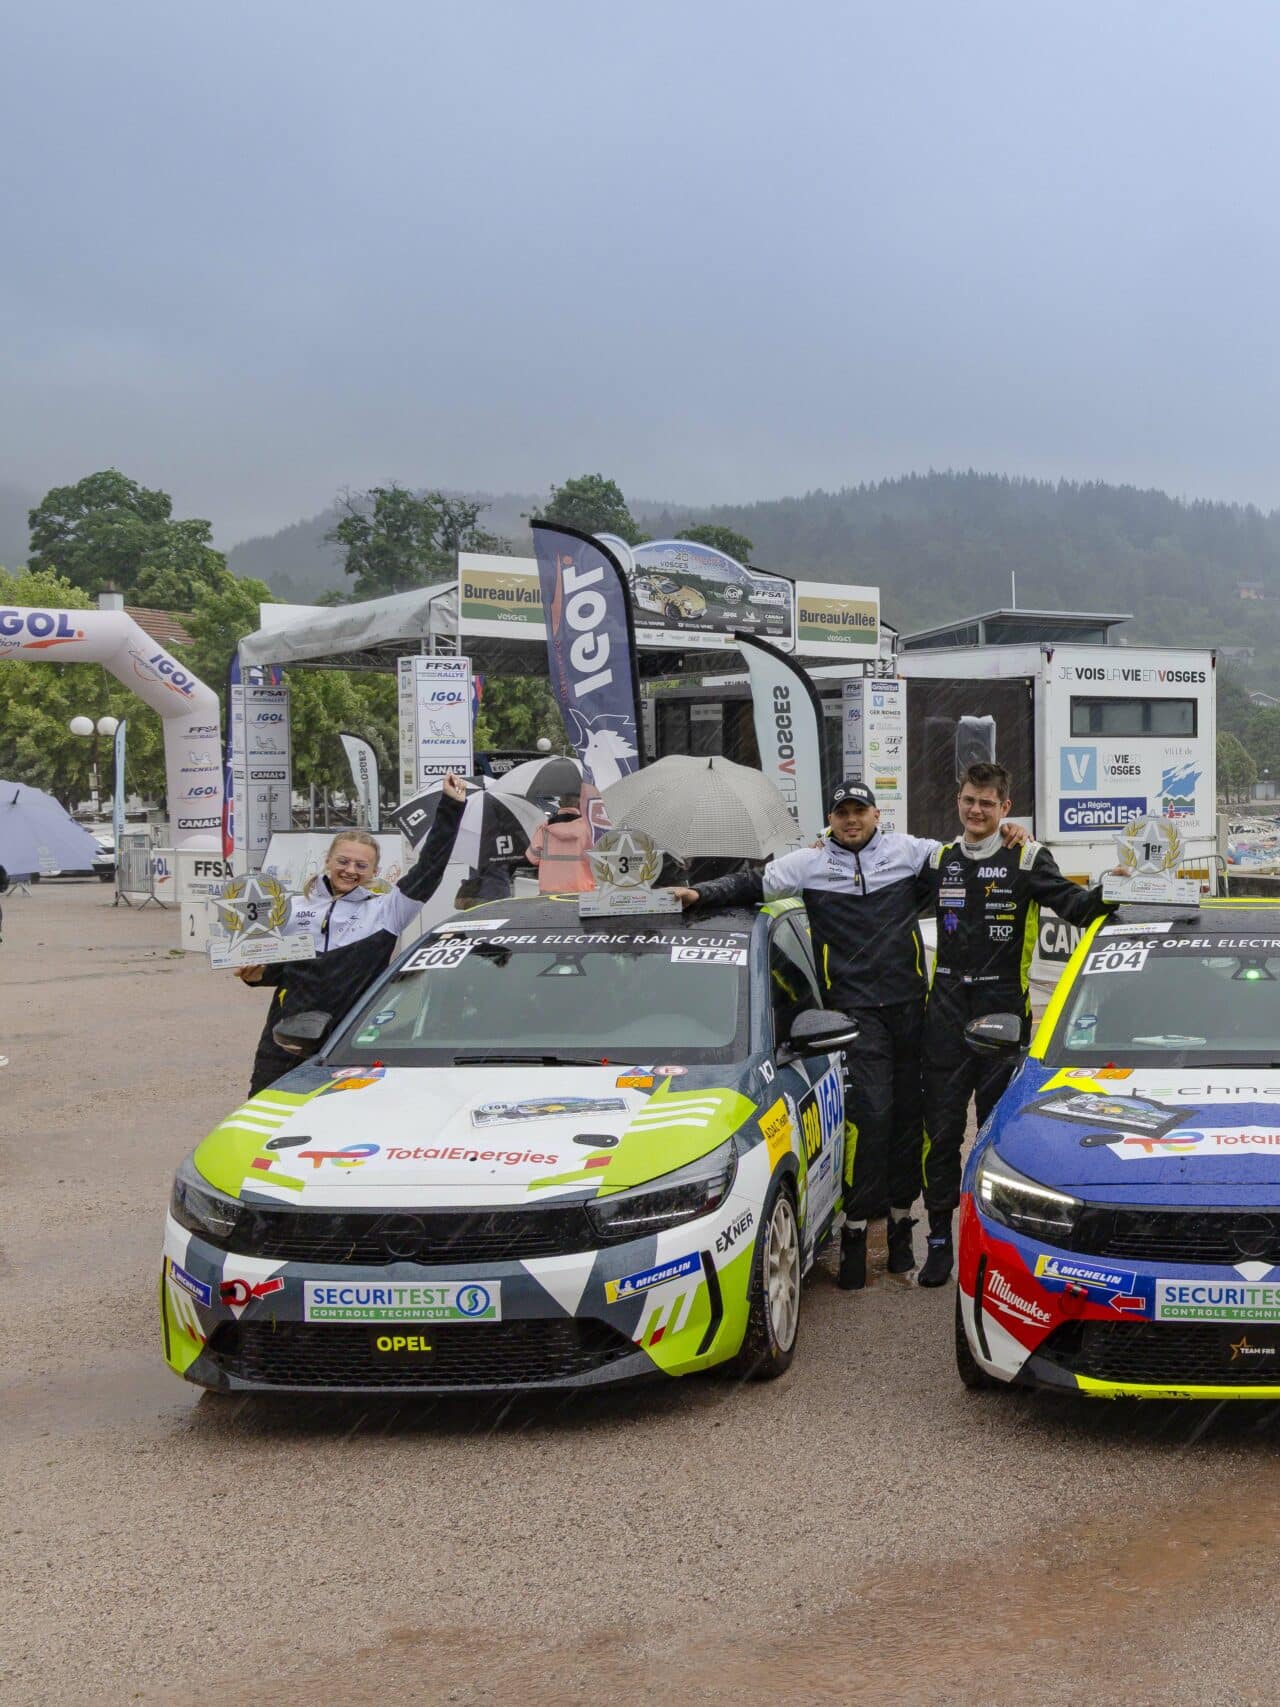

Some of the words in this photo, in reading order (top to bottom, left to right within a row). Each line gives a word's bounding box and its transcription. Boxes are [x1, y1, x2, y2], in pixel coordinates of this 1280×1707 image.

[464, 584, 540, 603] BureauVall
[425, 662, 461, 670] FFSA
[1075, 668, 1105, 680] VOIS
[1122, 670, 1141, 681] VIE
[1158, 670, 1206, 683] VOSGES
[431, 692, 462, 701] IGOL
[257, 713, 283, 721] IGOL
[1114, 754, 1130, 763] VIE
[425, 766, 465, 774] CANAL+
[1104, 765, 1141, 775] VOSGES
[188, 785, 217, 796] IGOL
[1087, 801, 1111, 810] Région
[179, 818, 221, 828] CANAL+
[194, 861, 233, 877] FFSA
[619, 857, 629, 873] 3
[977, 867, 1008, 878] ADAC
[247, 903, 258, 921] 3
[989, 925, 1013, 936] FKP
[1040, 922, 1086, 954] CAN
[431, 937, 487, 948] ADAC
[489, 935, 538, 945] OPEL
[541, 935, 630, 945] ELECTRIC
[633, 935, 693, 946] RALLY
[697, 937, 738, 947] CUP
[1102, 940, 1158, 951] ADAC
[1162, 939, 1212, 948] OPEL
[409, 948, 465, 967] E08
[1089, 952, 1141, 971] E04
[818, 1068, 843, 1146] IGOL
[803, 1102, 821, 1160] E08
[385, 1147, 558, 1166] TotalEnergies
[715, 1212, 754, 1253] EXNER
[636, 1261, 692, 1288] MICHELIN
[1061, 1266, 1121, 1285] MICHELIN
[313, 1288, 450, 1305] SECURITEST
[988, 1270, 1051, 1324] Milwaukee
[312, 1309, 376, 1318] CONTROLE
[380, 1310, 450, 1318] TECHNIQUE
[1164, 1308, 1228, 1318] CONTROLE
[376, 1336, 431, 1352] OPEL
